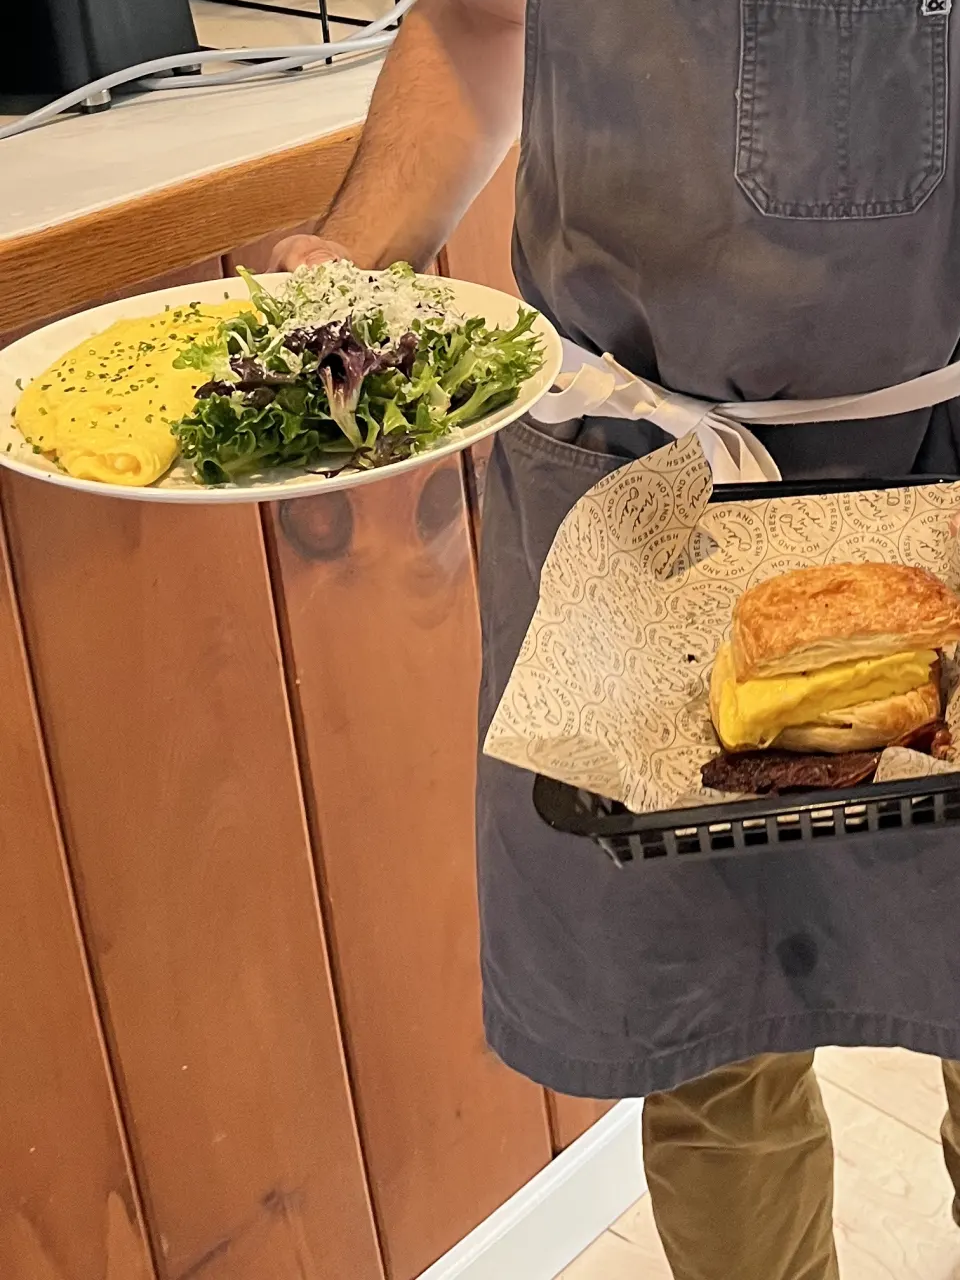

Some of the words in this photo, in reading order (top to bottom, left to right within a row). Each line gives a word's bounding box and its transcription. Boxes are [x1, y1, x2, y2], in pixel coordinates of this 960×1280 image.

[614, 475, 643, 495] FRESH
[655, 481, 670, 498] HOT
[676, 479, 686, 498] AND
[589, 507, 601, 524] HOT
[607, 499, 615, 519] AND
[659, 503, 670, 522] AND
[676, 504, 689, 520] HOT
[828, 501, 838, 533] FRESH
[769, 506, 778, 538] FRESH
[853, 518, 872, 532] AND
[876, 522, 895, 532] HOT
[920, 515, 939, 526] HOT
[609, 524, 621, 541] HOT
[631, 524, 660, 544] FRESH
[712, 509, 732, 521] HOT
[737, 511, 754, 526] AND
[752, 526, 763, 557] FRESH
[648, 533, 679, 552] FRESH
[778, 539, 797, 552] AND
[800, 543, 820, 554] HOT
[846, 536, 865, 546] HOT
[871, 537, 888, 548] AND
[702, 564, 721, 576] AND
[726, 566, 745, 576] HOT
[771, 559, 791, 569] HOT
[716, 584, 734, 593] AND
